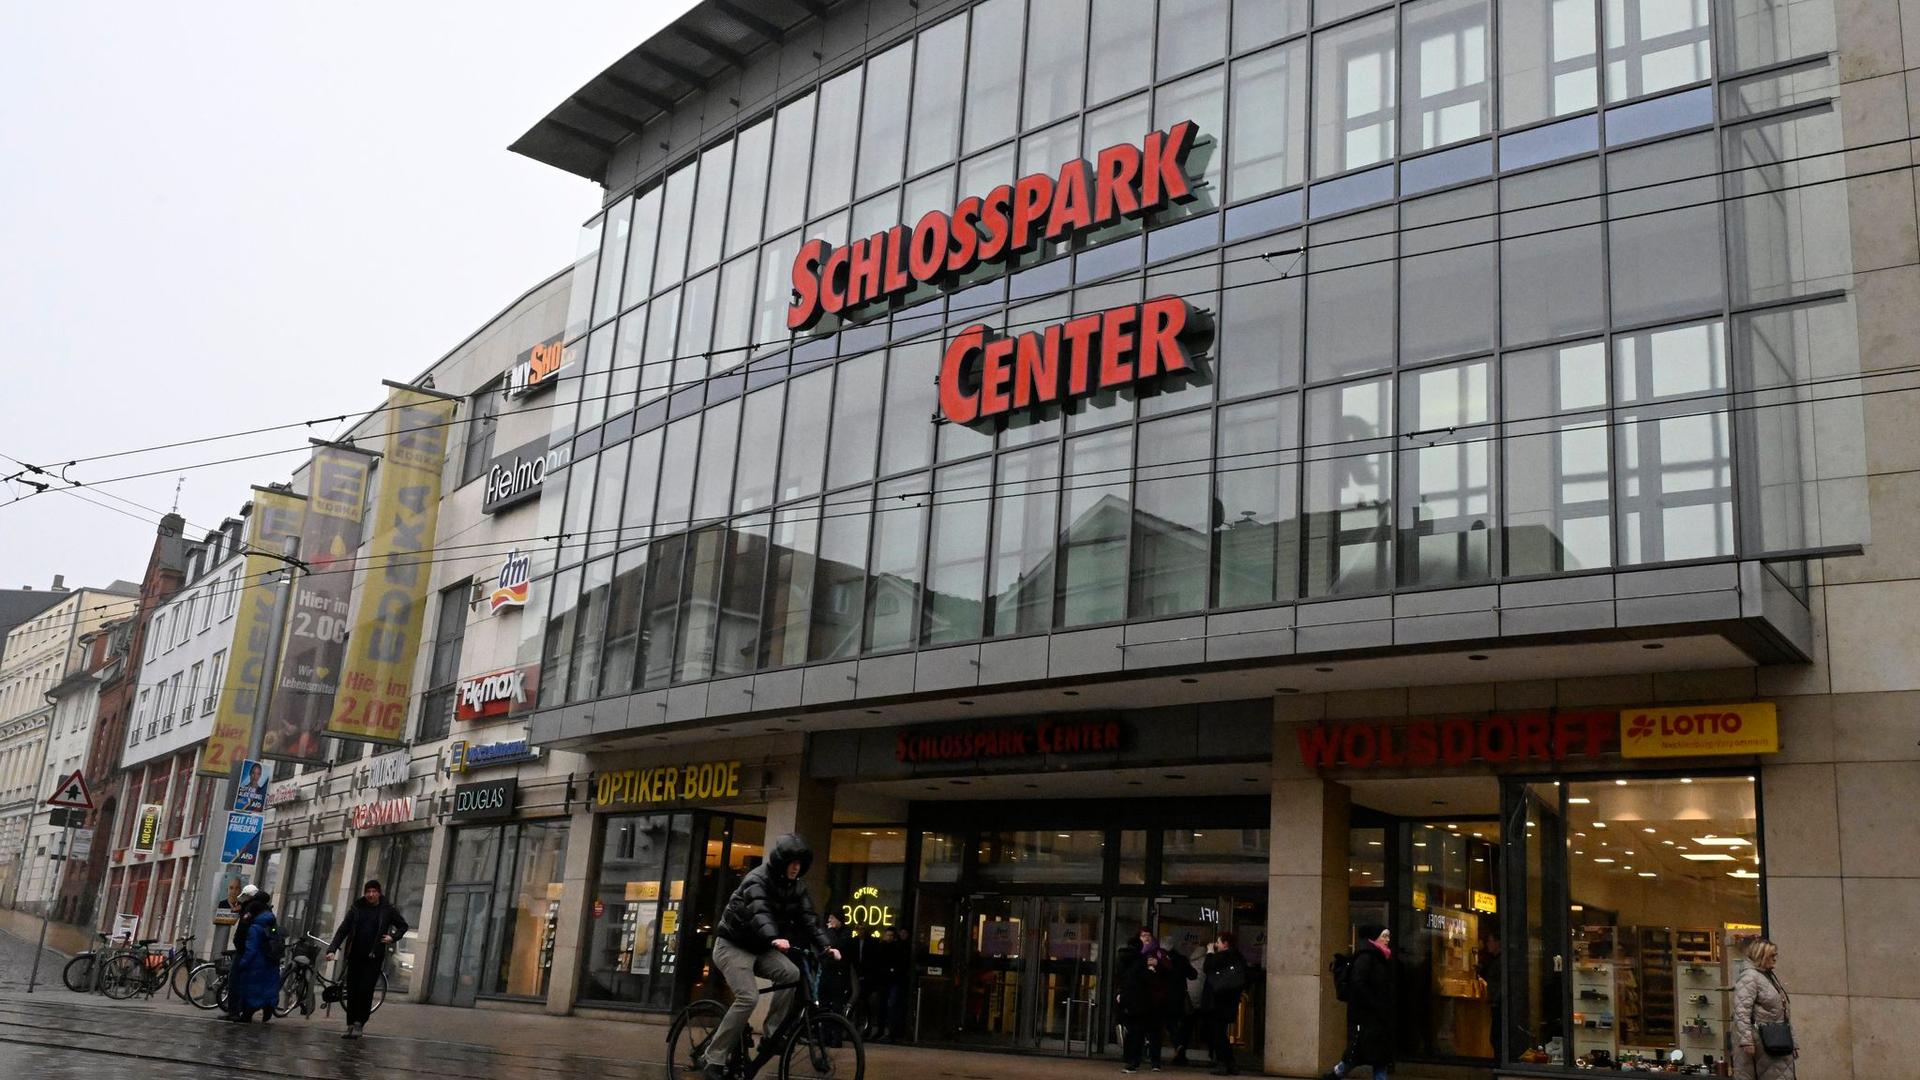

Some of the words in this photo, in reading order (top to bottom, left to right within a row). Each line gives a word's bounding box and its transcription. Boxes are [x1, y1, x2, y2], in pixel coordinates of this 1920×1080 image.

[787, 119, 1199, 331] SCHLOSSPARK
[938, 293, 1194, 425] CENTER
[368, 486, 431, 663] EDEKA
[499, 549, 529, 588] dm
[299, 588, 329, 612] Hier
[334, 597, 348, 614] im
[344, 671, 378, 690] Hier
[386, 674, 407, 697] im
[215, 721, 245, 739] Hier
[1661, 712, 1742, 736] LOTTO
[1295, 710, 1617, 769] WOLSDORFF
[597, 766, 678, 806] OPTIKER
[684, 761, 741, 800] BODE
[352, 796, 413, 829] ROSSMANN
[457, 787, 505, 812] DOUGLAS
[228, 823, 258, 834] FRIEDEN.
[230, 815, 245, 824] ZEIT
[245, 816, 259, 826] FÜR
[853, 886, 879, 900] OPTIKE
[842, 904, 893, 926] BODE
